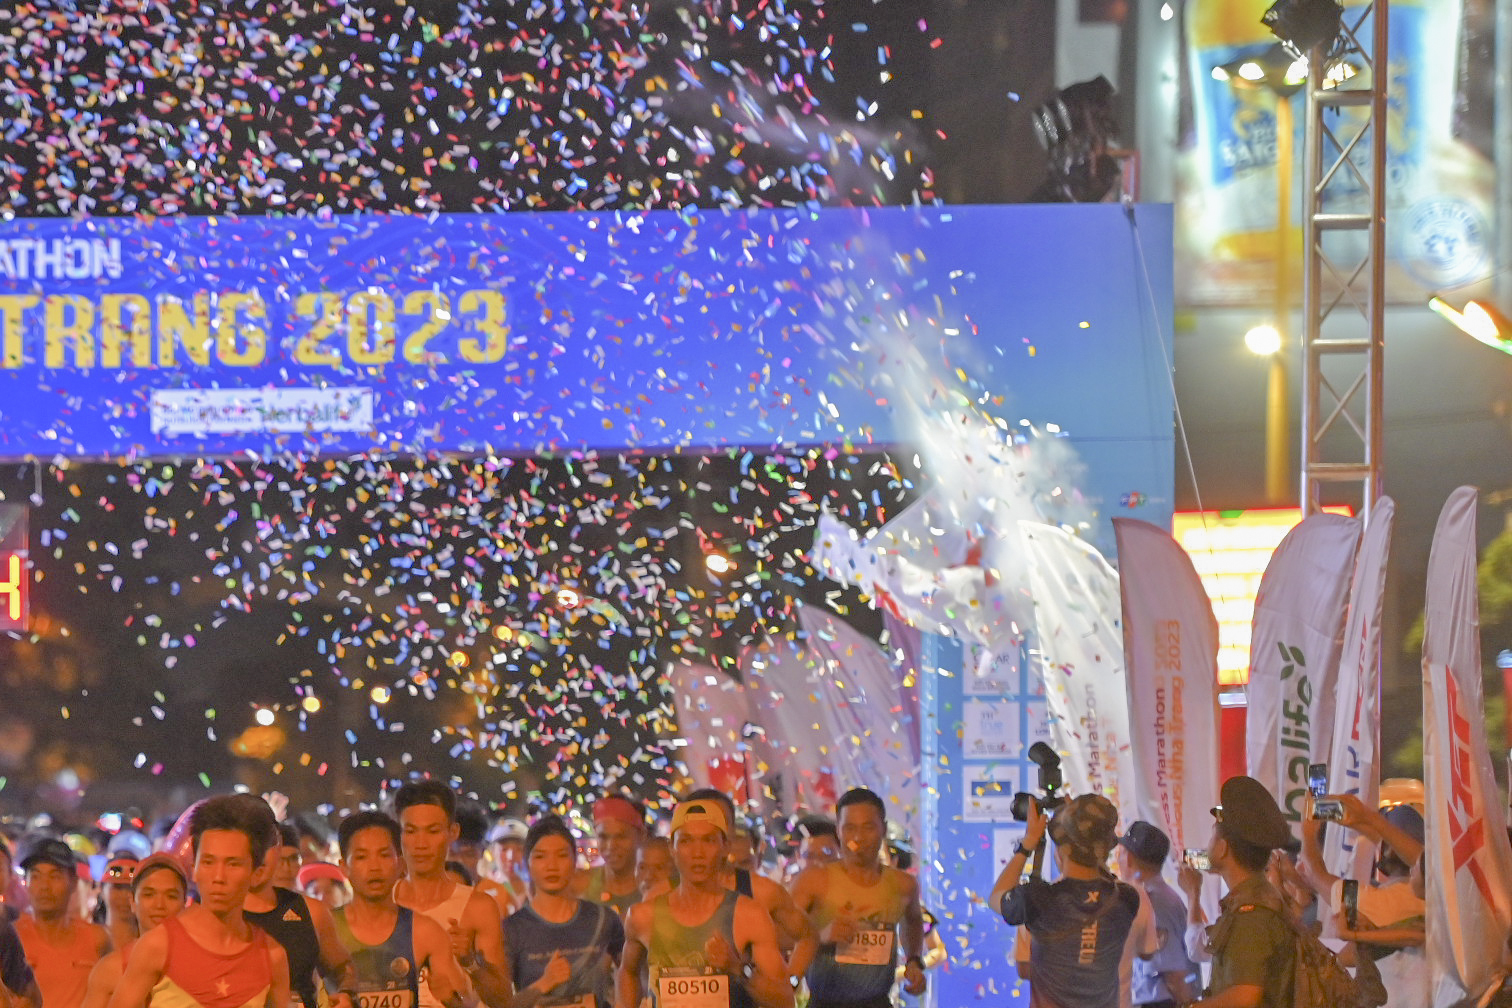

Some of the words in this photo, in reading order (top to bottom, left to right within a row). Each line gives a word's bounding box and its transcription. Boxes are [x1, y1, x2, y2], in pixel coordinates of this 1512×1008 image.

[293, 288, 509, 365] 2023
[1168, 619, 1181, 671] 2023
[1155, 688, 1168, 788] Marathon
[667, 979, 720, 995] 80510
